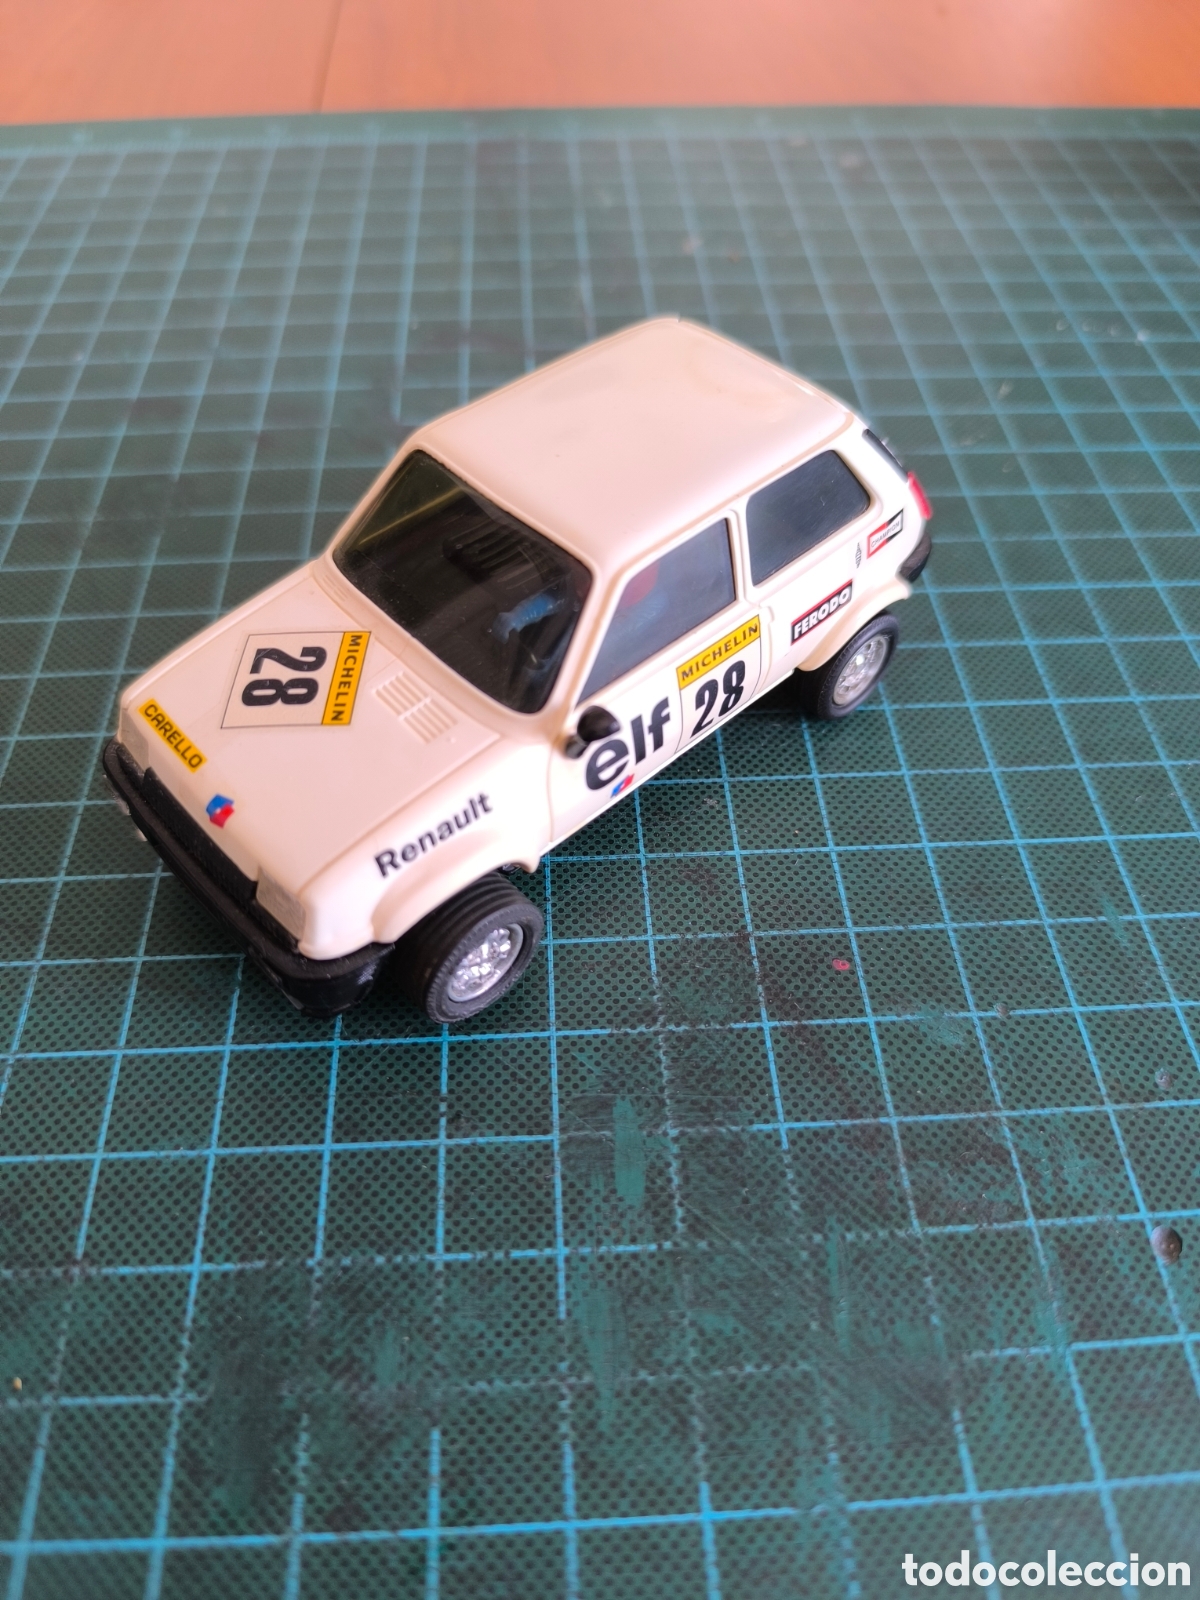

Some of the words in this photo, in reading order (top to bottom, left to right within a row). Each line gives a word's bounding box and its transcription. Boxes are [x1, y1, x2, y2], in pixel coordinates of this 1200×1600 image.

[871, 521, 900, 548] CHAMPION
[794, 587, 850, 640] FERODO
[241, 646, 328, 707] 28
[330, 634, 363, 722] MICHELIN
[681, 623, 758, 682] MICHELIN
[690, 660, 746, 739] 28
[143, 703, 204, 770] CARELLO
[585, 696, 671, 791] elf
[373, 792, 493, 879] Renault
